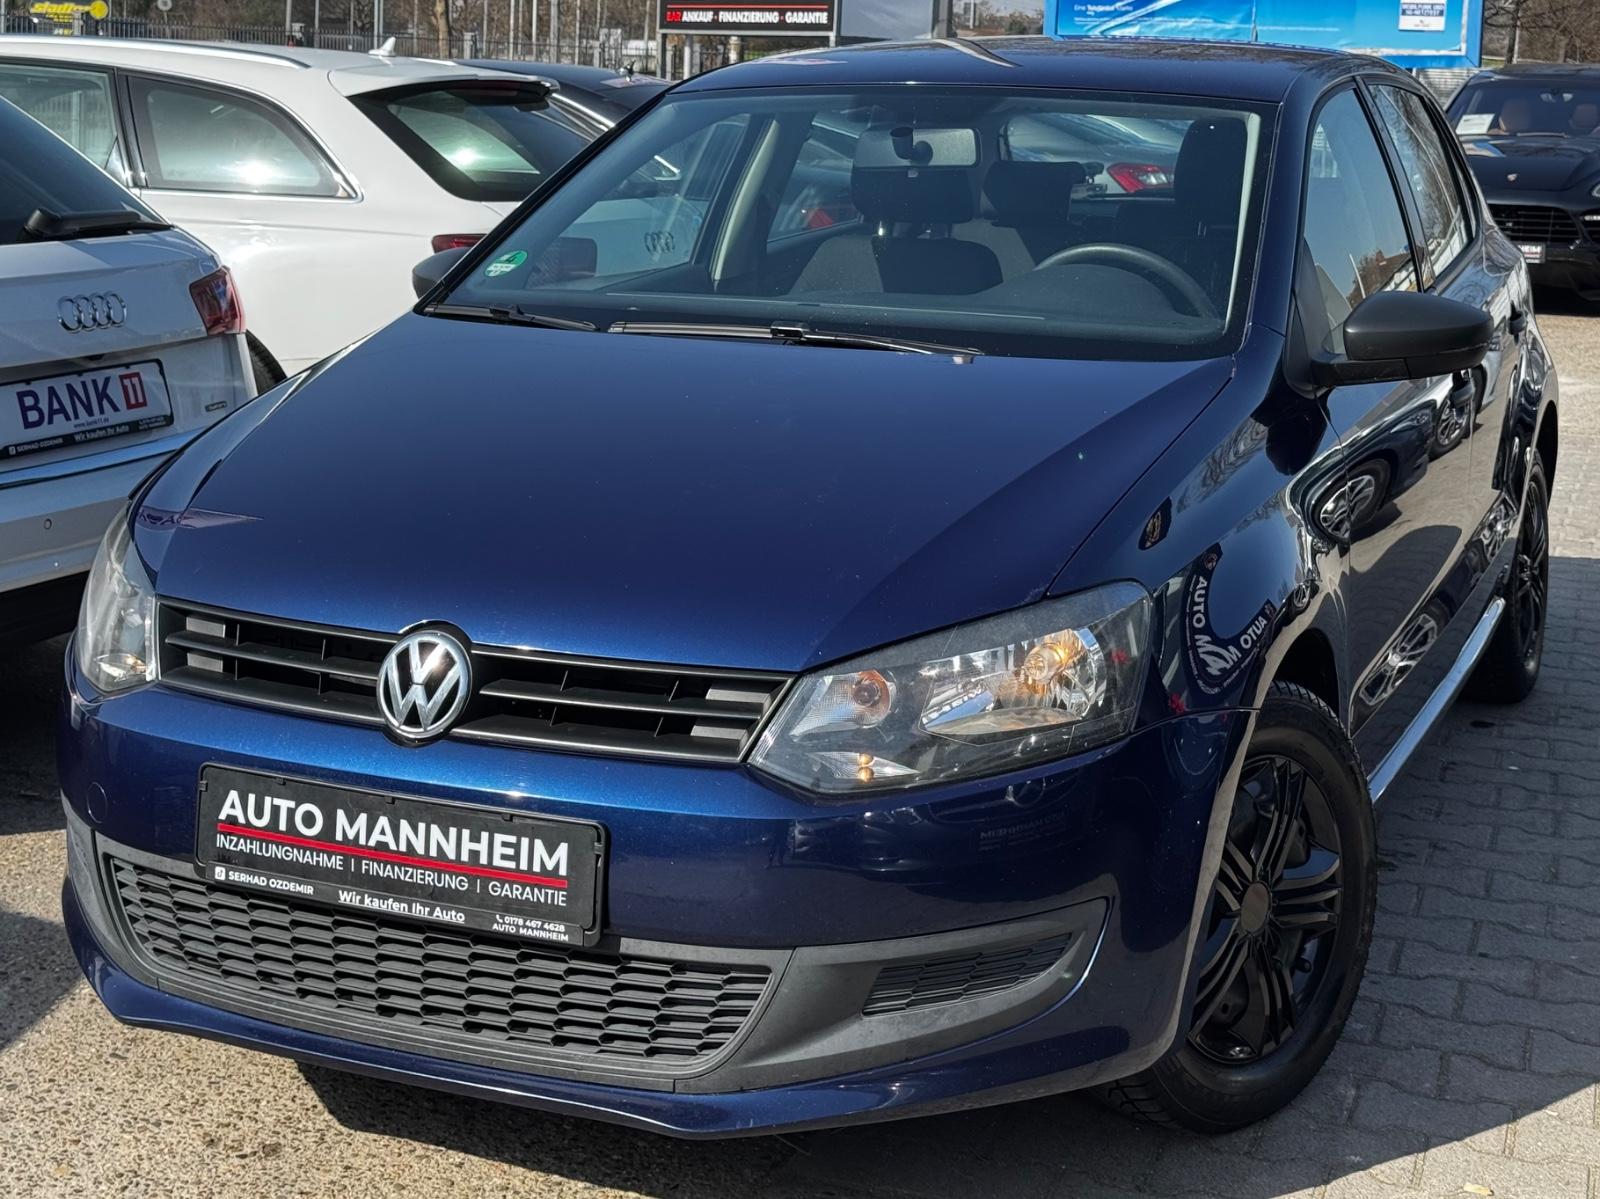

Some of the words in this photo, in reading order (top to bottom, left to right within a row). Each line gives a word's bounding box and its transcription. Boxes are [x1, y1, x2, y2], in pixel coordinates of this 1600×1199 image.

[719, 11, 779, 23] FINANZIERUNG
[785, 12, 828, 24] GARANTIE
[16, 376, 120, 430] BANK
[121, 375, 146, 407] 11
[73, 432, 86, 441] Wir
[115, 425, 129, 434] Auto
[218, 790, 323, 837] AUTO
[335, 808, 569, 876] MANNHEIM
[216, 834, 344, 870] INZAHLUNGNAHME
[361, 860, 468, 891] FINANZIERUNG
[488, 881, 567, 906] GARANTIE
[228, 870, 267, 886] SERHAD
[269, 878, 314, 895] OZDEMIR
[339, 890, 361, 904] Wir
[364, 893, 408, 912] kaufen
[412, 903, 430, 916] Ihr
[433, 906, 465, 922] Auto
[492, 923, 516, 933] AUTO
[519, 926, 569, 942] MANNHEIM
[504, 916, 523, 925] 0178
[525, 919, 542, 928] 467
[543, 922, 565, 932] 4628
